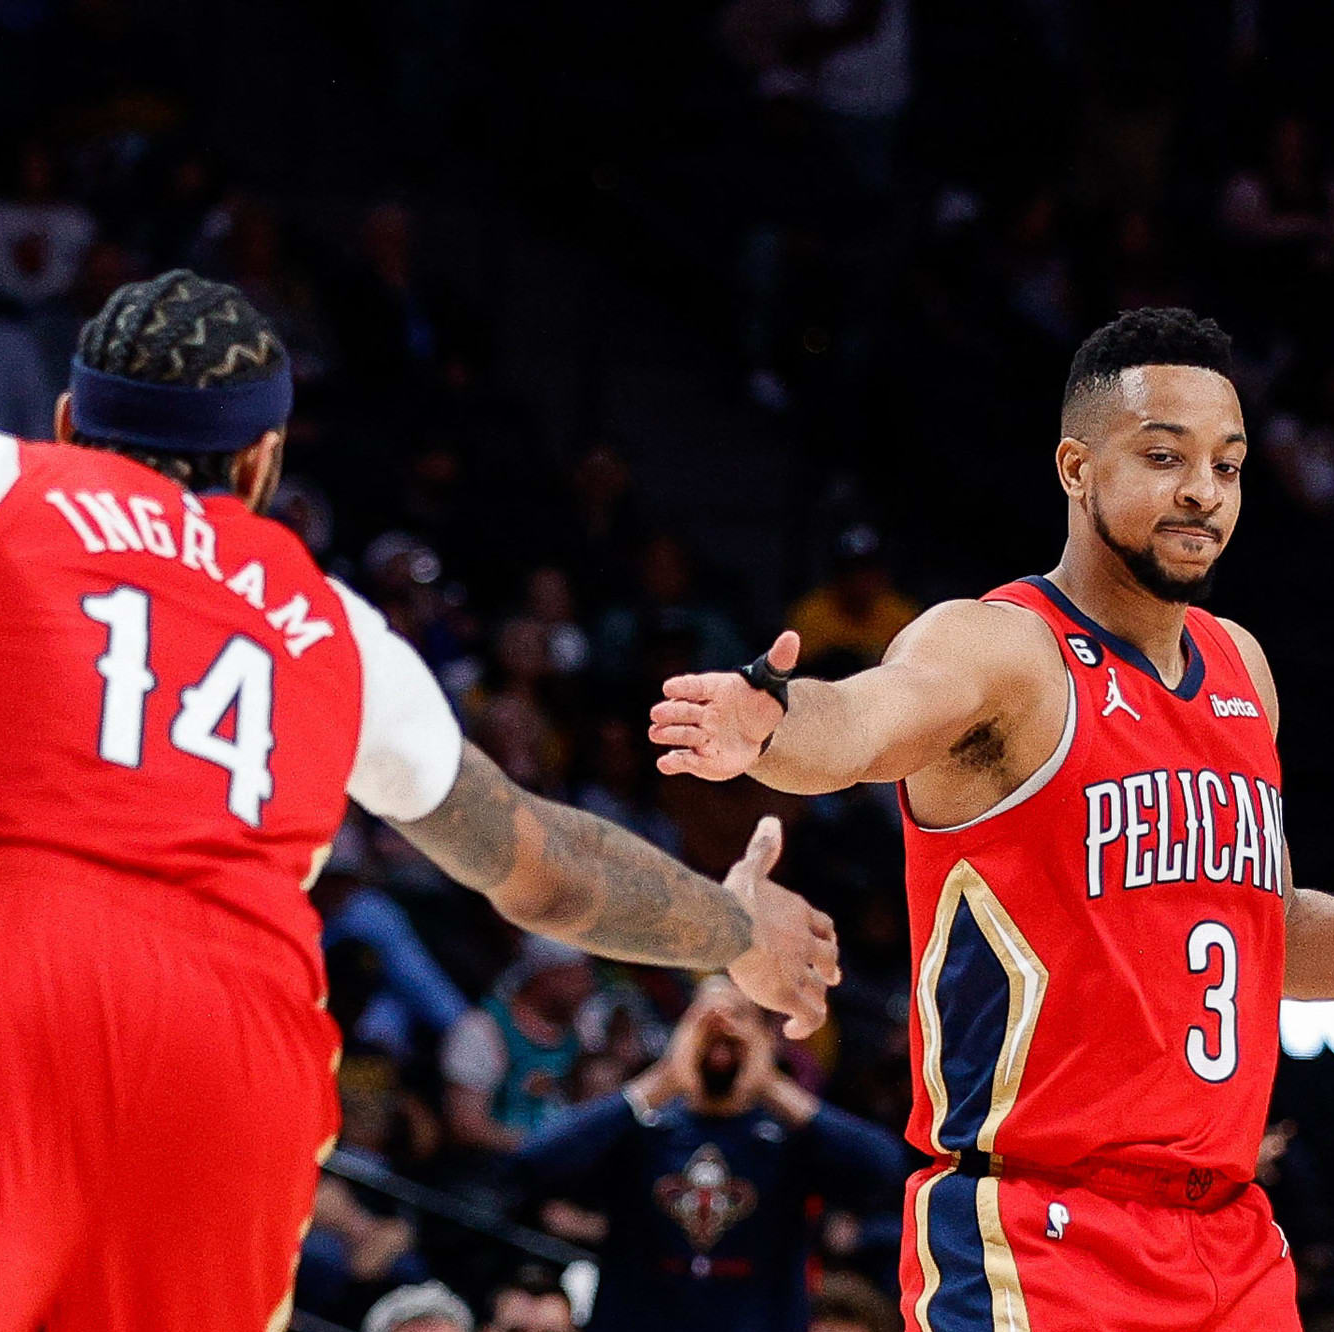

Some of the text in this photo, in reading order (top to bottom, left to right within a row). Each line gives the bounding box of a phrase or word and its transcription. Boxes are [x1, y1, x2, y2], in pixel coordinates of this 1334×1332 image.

[44, 488, 335, 660] INGRAM
[1067, 636, 1097, 665] 6
[80, 583, 276, 829] 14
[1209, 694, 1259, 718] ibotta
[1186, 920, 1237, 1083] 3
